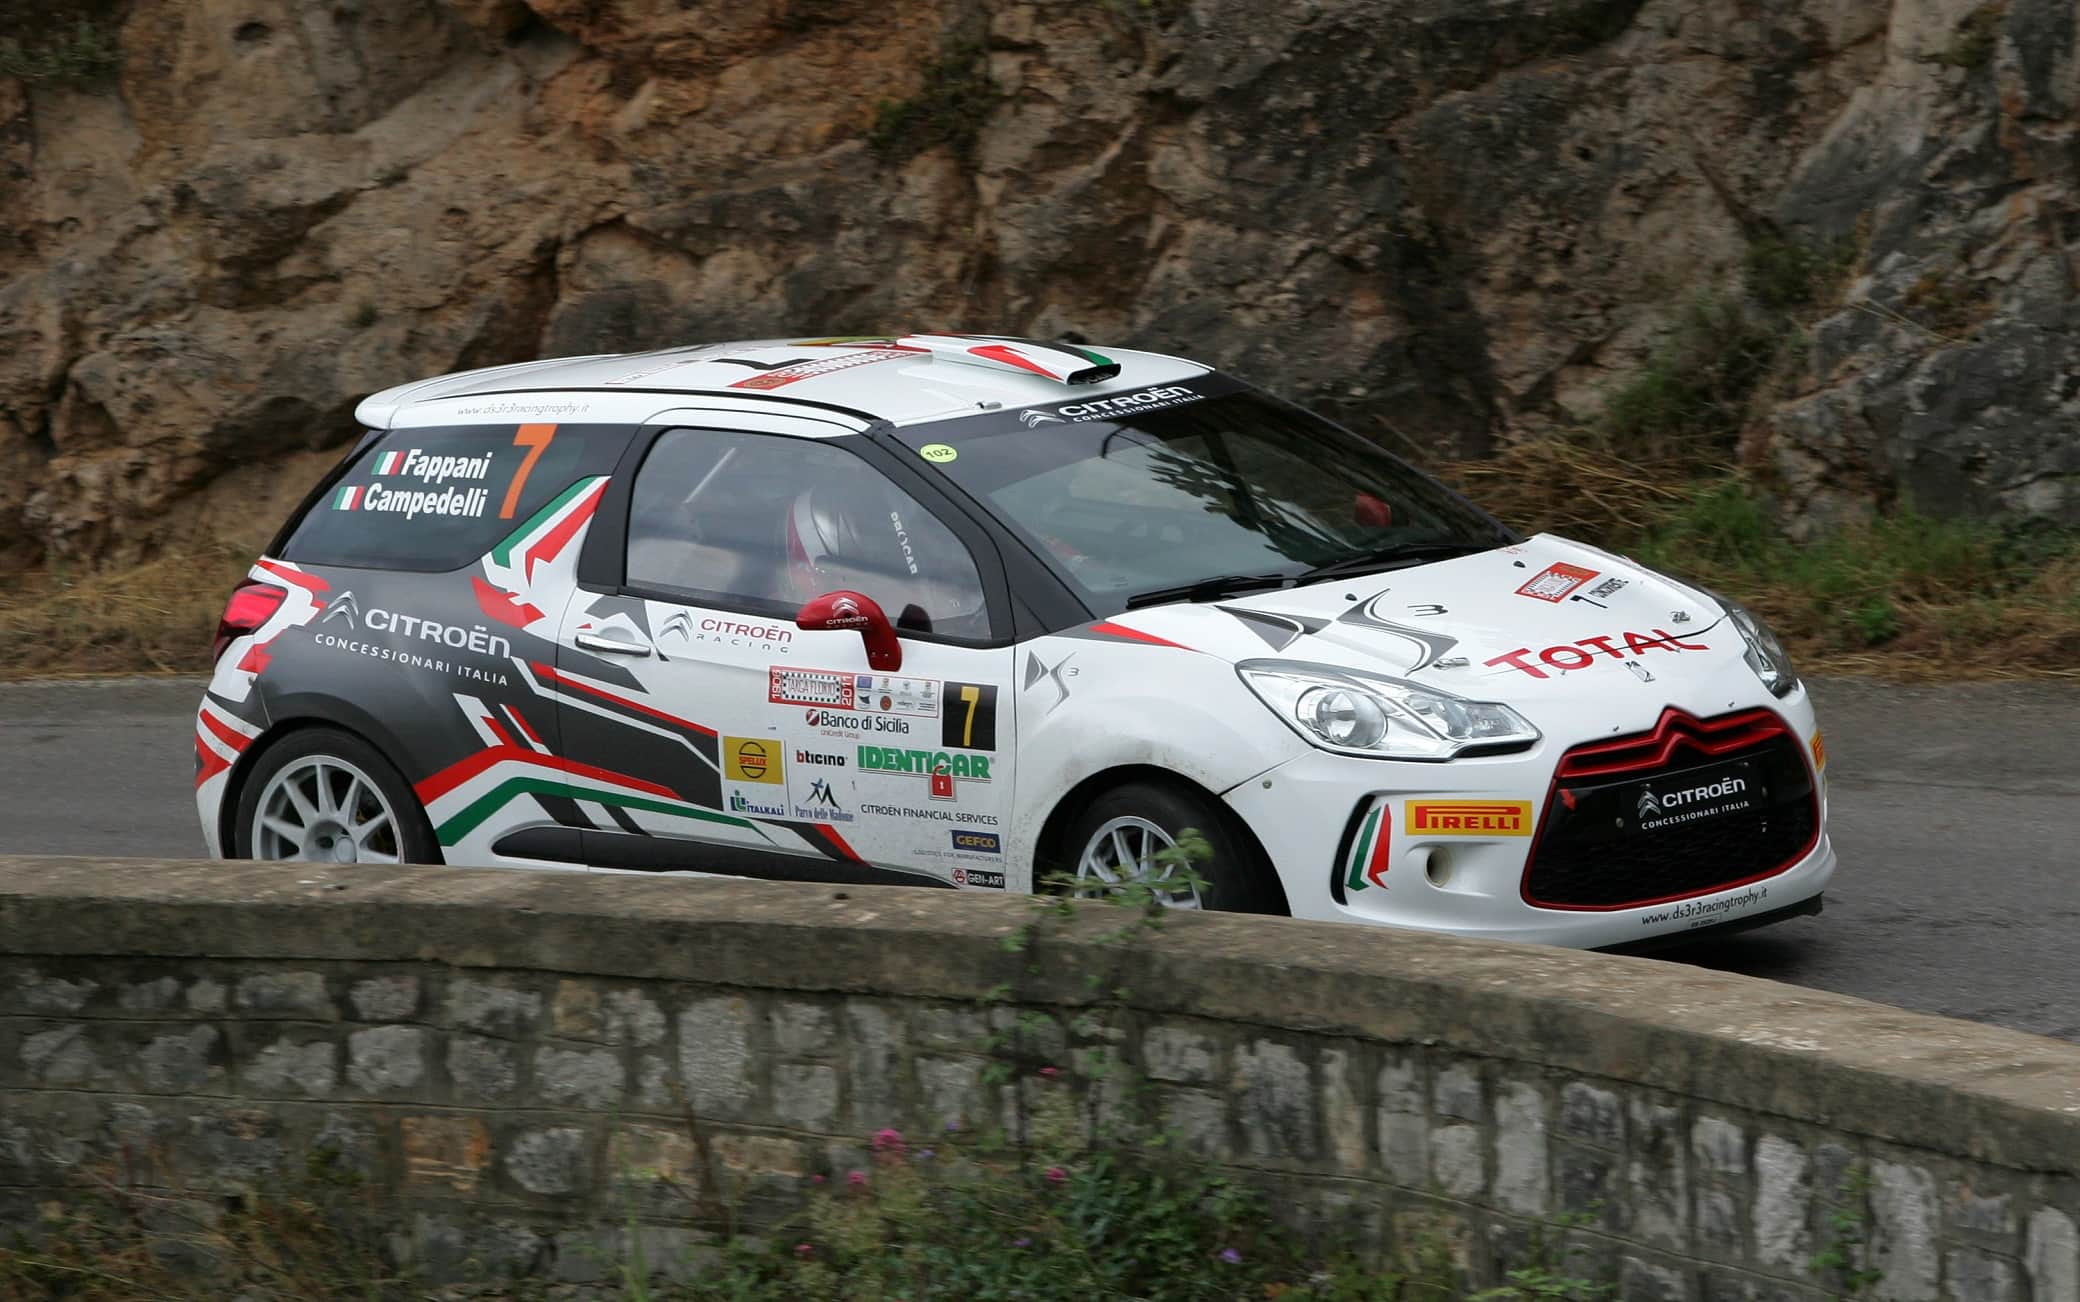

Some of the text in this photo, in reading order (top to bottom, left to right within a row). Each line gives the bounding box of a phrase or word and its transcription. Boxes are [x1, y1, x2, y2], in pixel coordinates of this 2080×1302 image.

[1073, 394, 1206, 423] CONCESSIONARI ITALIA
[400, 448, 493, 484] Fappani
[926, 448, 953, 458] 102
[498, 423, 558, 519] 7
[363, 482, 488, 520] Campedelli
[696, 633, 790, 653] RACING
[1482, 628, 1710, 679] TOTAL
[314, 633, 508, 686] CONCESSIONARI ITALIA
[841, 674, 853, 706] 2011
[820, 710, 910, 734] Banco di Sicilia
[960, 685, 980, 747] 7
[796, 749, 845, 767] bticino
[857, 745, 992, 780] IDENTICAR
[903, 807, 954, 822] FINANCIAL
[955, 812, 998, 826] SERVICES
[1415, 806, 1521, 830] PIRELLI
[1641, 800, 1750, 830] CONCESSIONARI ITALIA
[956, 835, 996, 849] GEFCO
[967, 872, 1003, 887] GEN-ART
[1641, 886, 1768, 926] www.ds3r3racingtrophy.it
